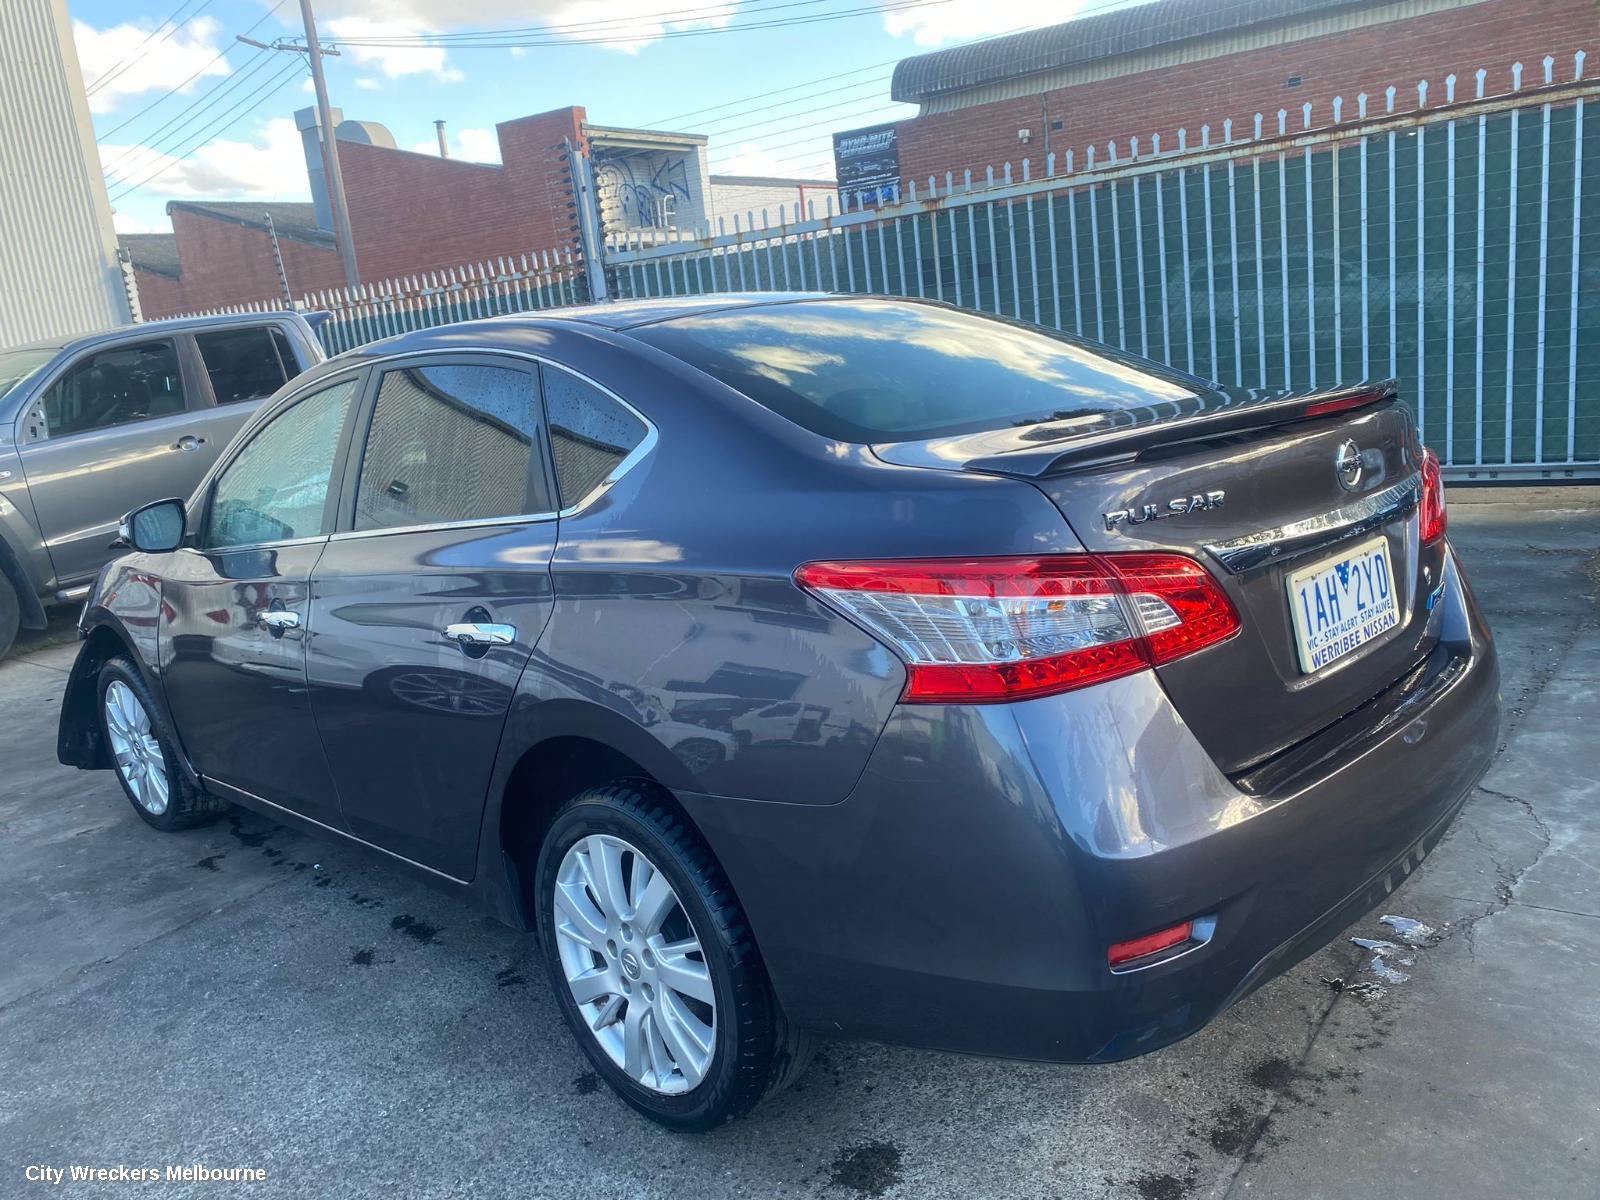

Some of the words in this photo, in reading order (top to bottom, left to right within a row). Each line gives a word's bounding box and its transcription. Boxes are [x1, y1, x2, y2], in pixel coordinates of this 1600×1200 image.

[1103, 490, 1225, 530] PULSAR
[1301, 574, 1342, 637] 1AH
[1351, 553, 1388, 612] 2YD
[1307, 636, 1319, 651] VIC
[1324, 626, 1340, 642] STAY
[1340, 615, 1358, 632] ALERT
[1360, 608, 1375, 623] STAY
[1375, 599, 1391, 615] ALIVE
[1311, 629, 1361, 669] WERRIBEE
[1363, 611, 1396, 640] NISSAN
